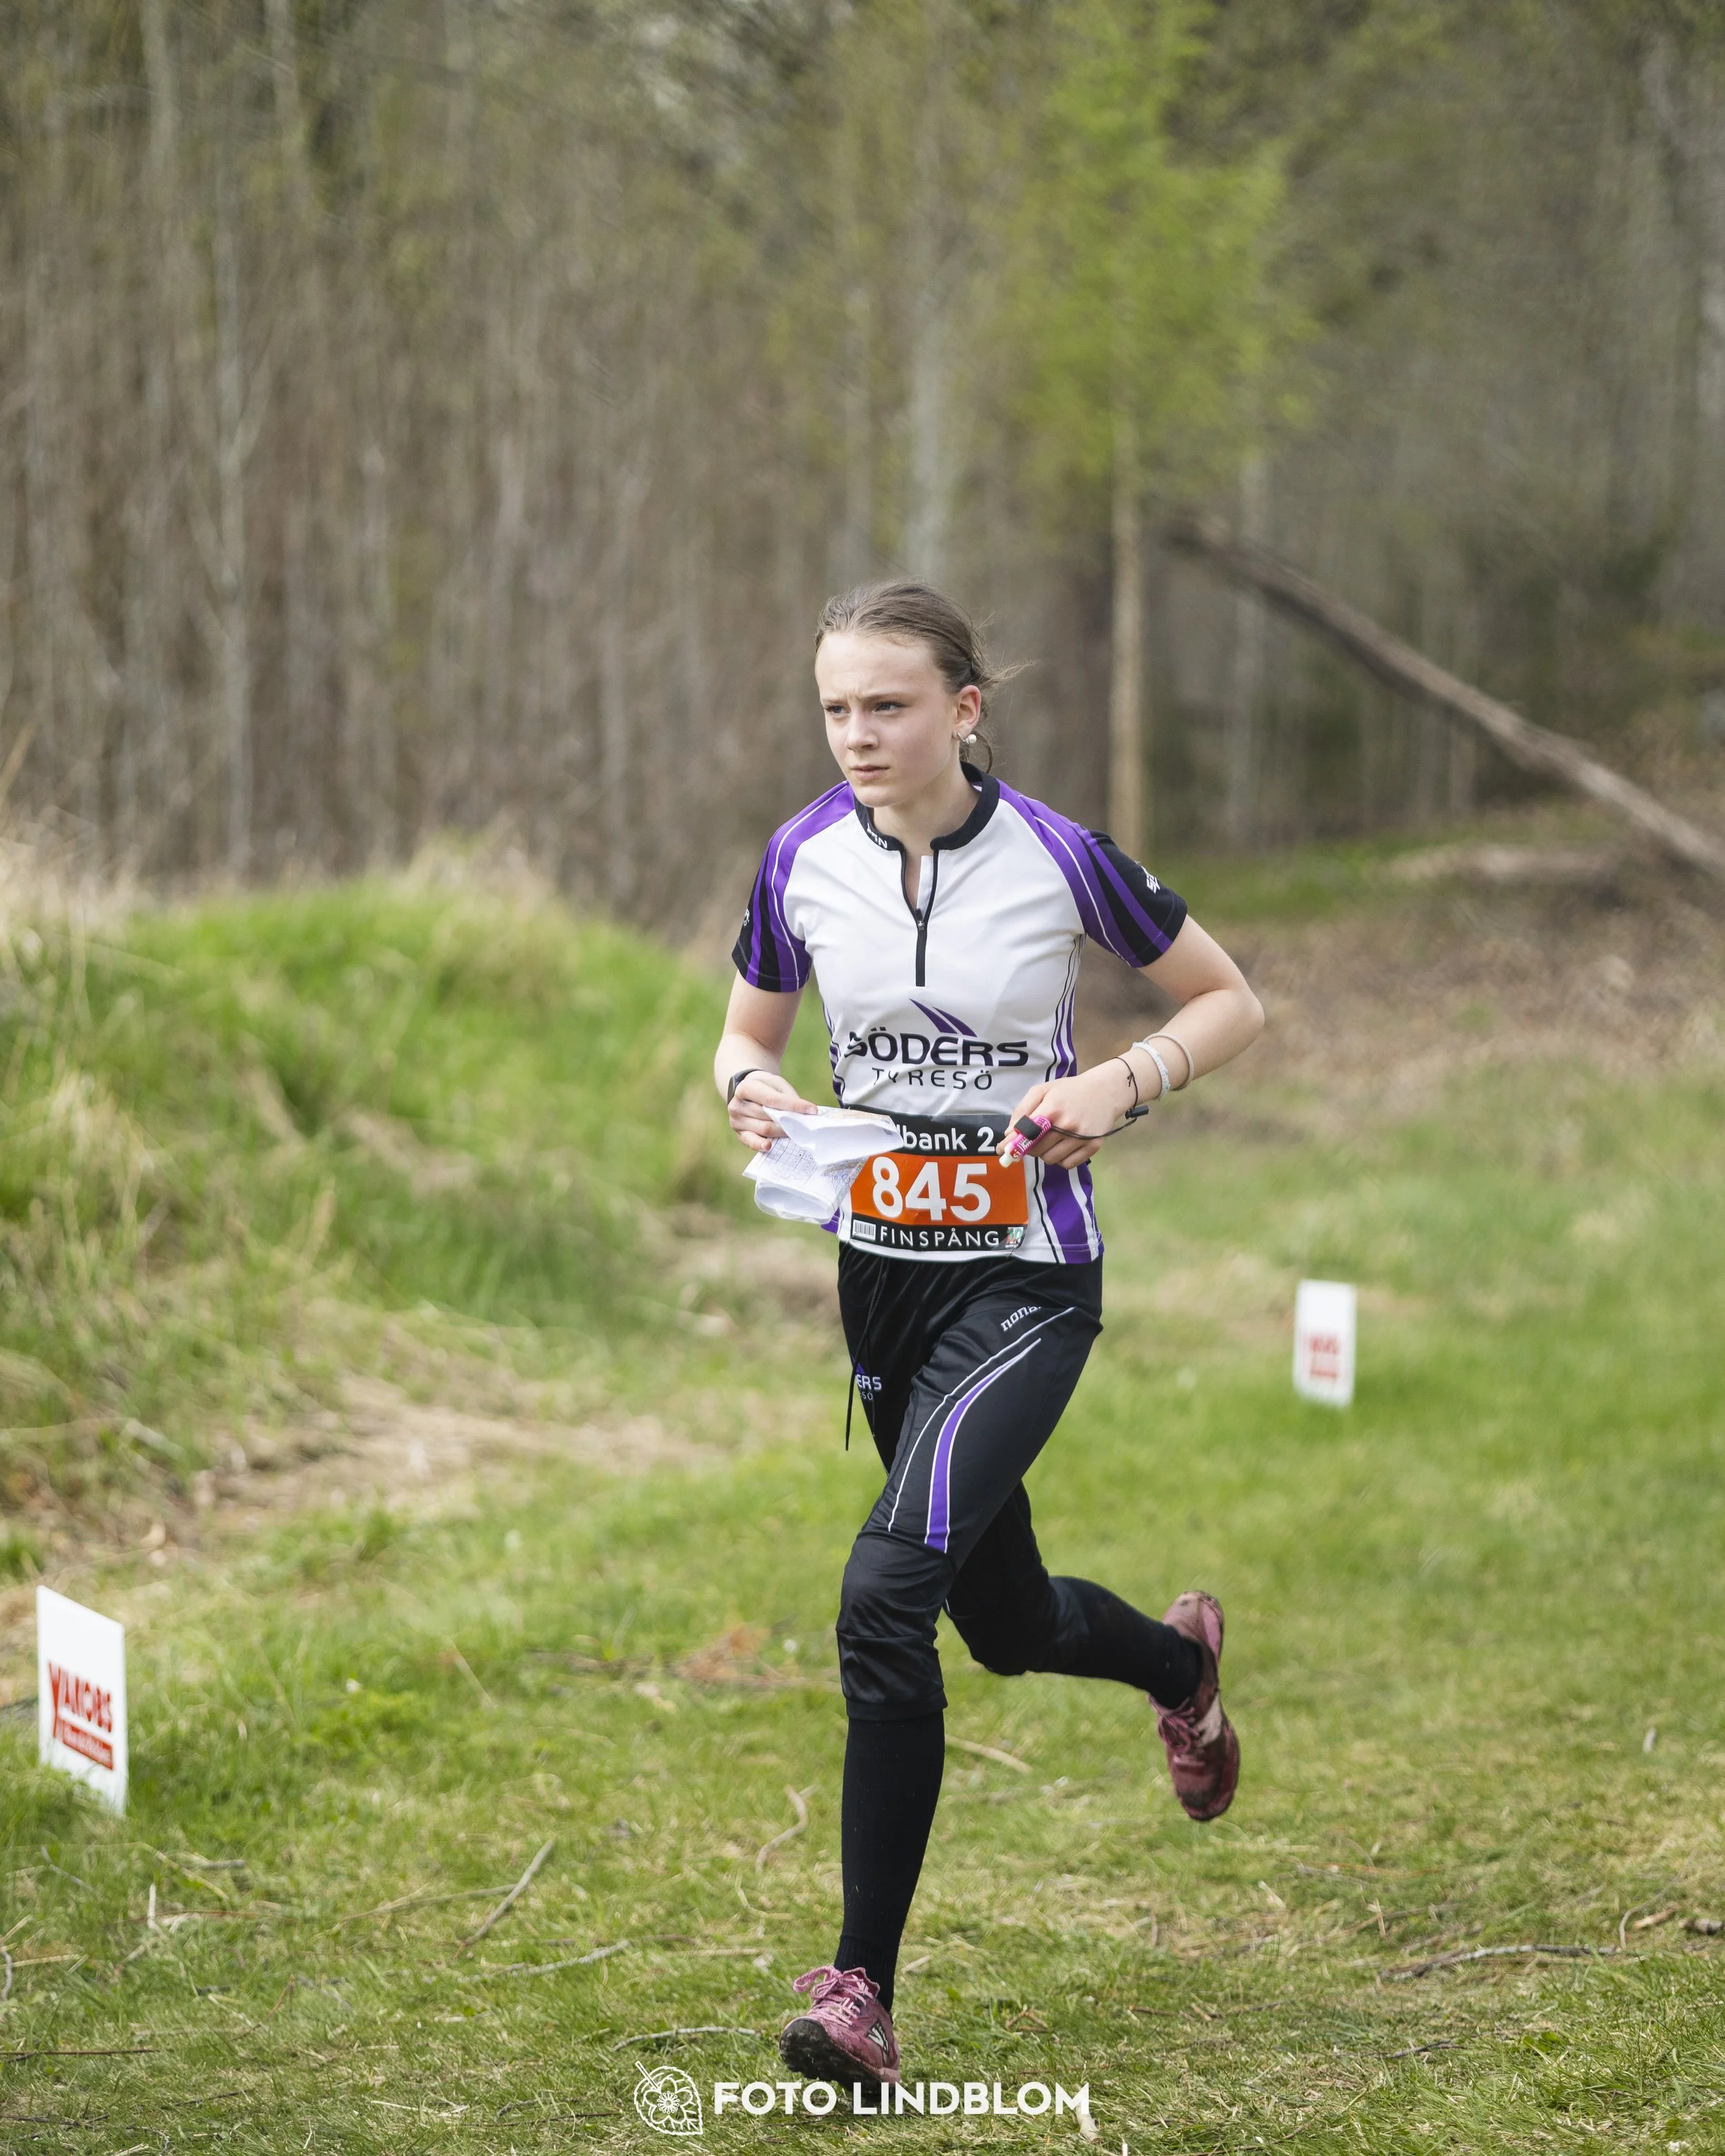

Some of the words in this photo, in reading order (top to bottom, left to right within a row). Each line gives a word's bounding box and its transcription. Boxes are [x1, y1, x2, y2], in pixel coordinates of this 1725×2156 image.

[843, 1026, 1029, 1067] SÖDERS
[871, 1067, 993, 1091] TYRESÖ
[896, 1124, 967, 1150] bank
[871, 1156, 992, 1222] 845
[880, 1226, 1000, 1247] FINSPÅNG
[1000, 1306, 1042, 1332] nona
